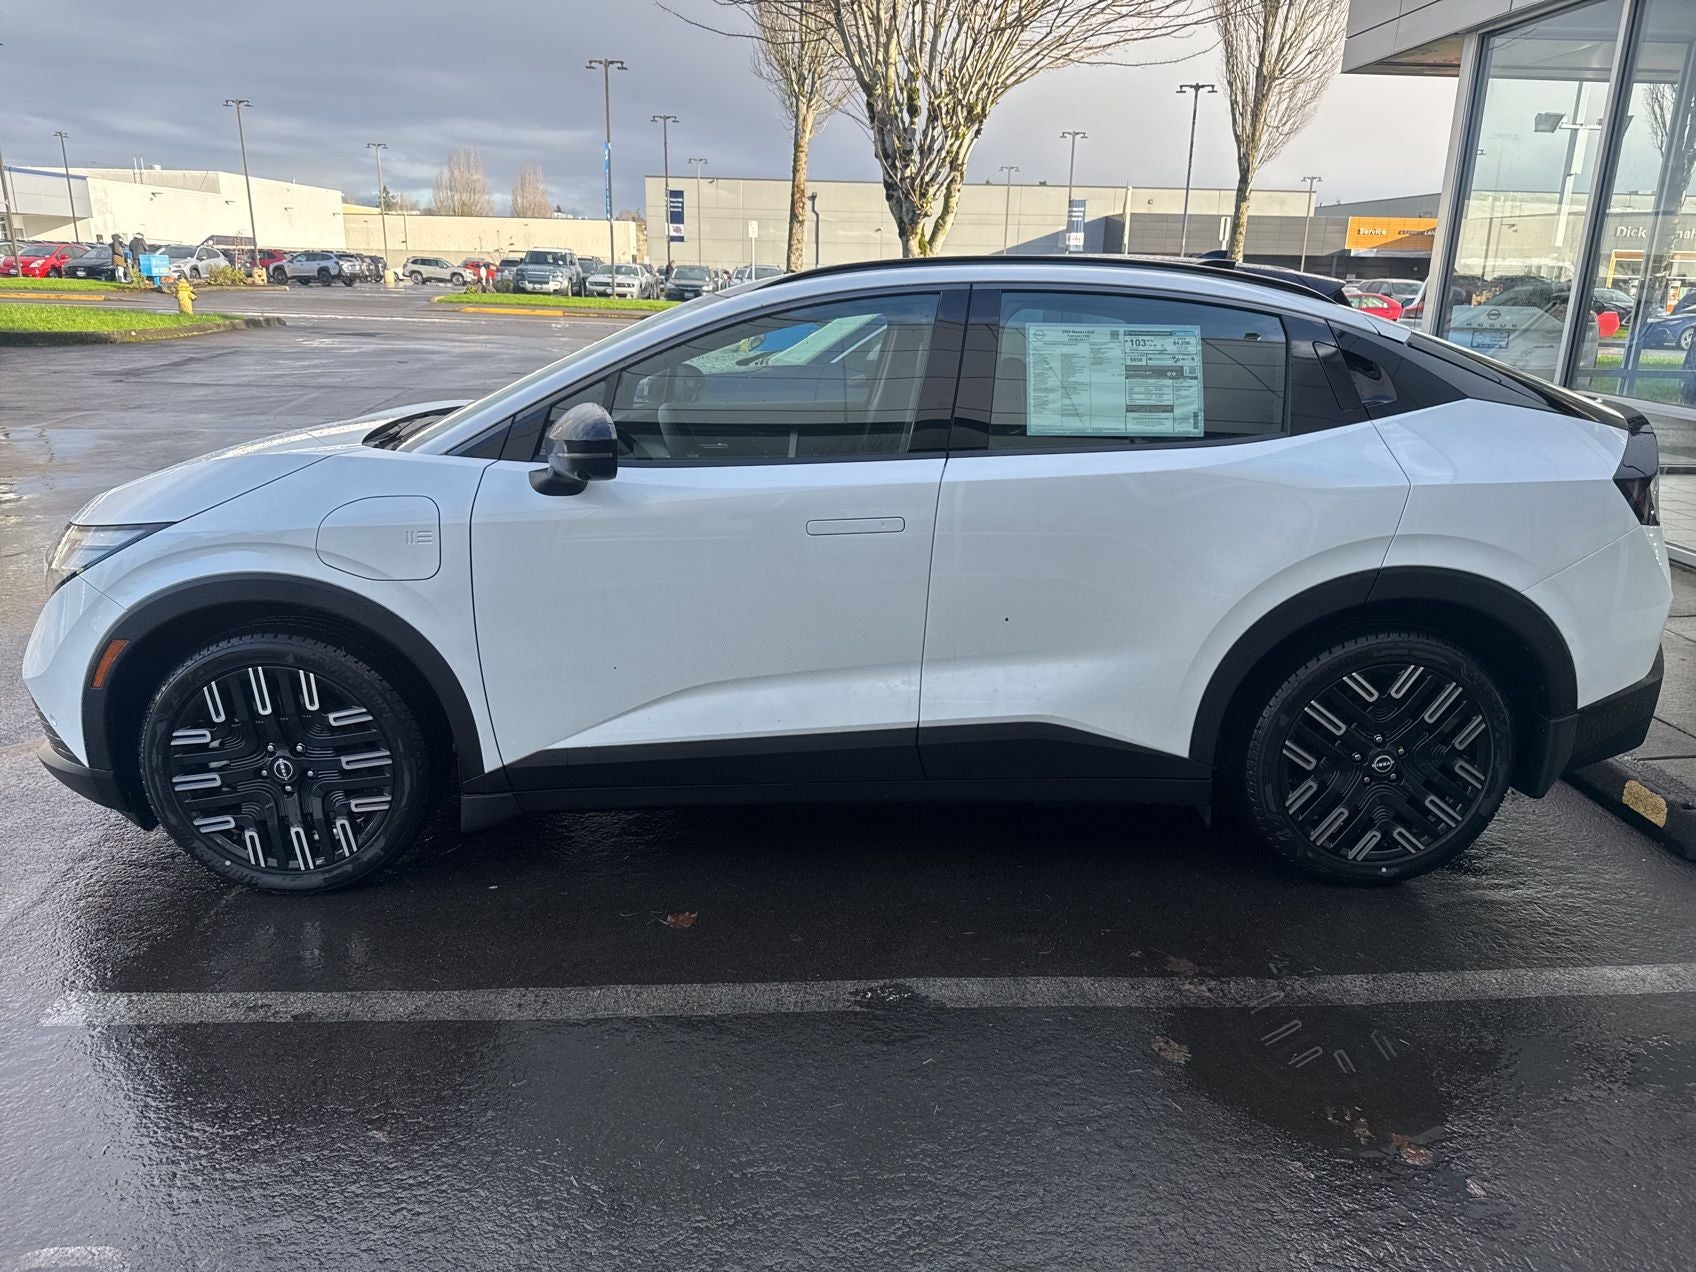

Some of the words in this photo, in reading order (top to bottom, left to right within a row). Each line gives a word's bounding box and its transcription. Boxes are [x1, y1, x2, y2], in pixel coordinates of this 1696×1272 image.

[1358, 227, 1387, 235] Service
[1616, 226, 1647, 238] Dick
[1130, 339, 1147, 347] 103
